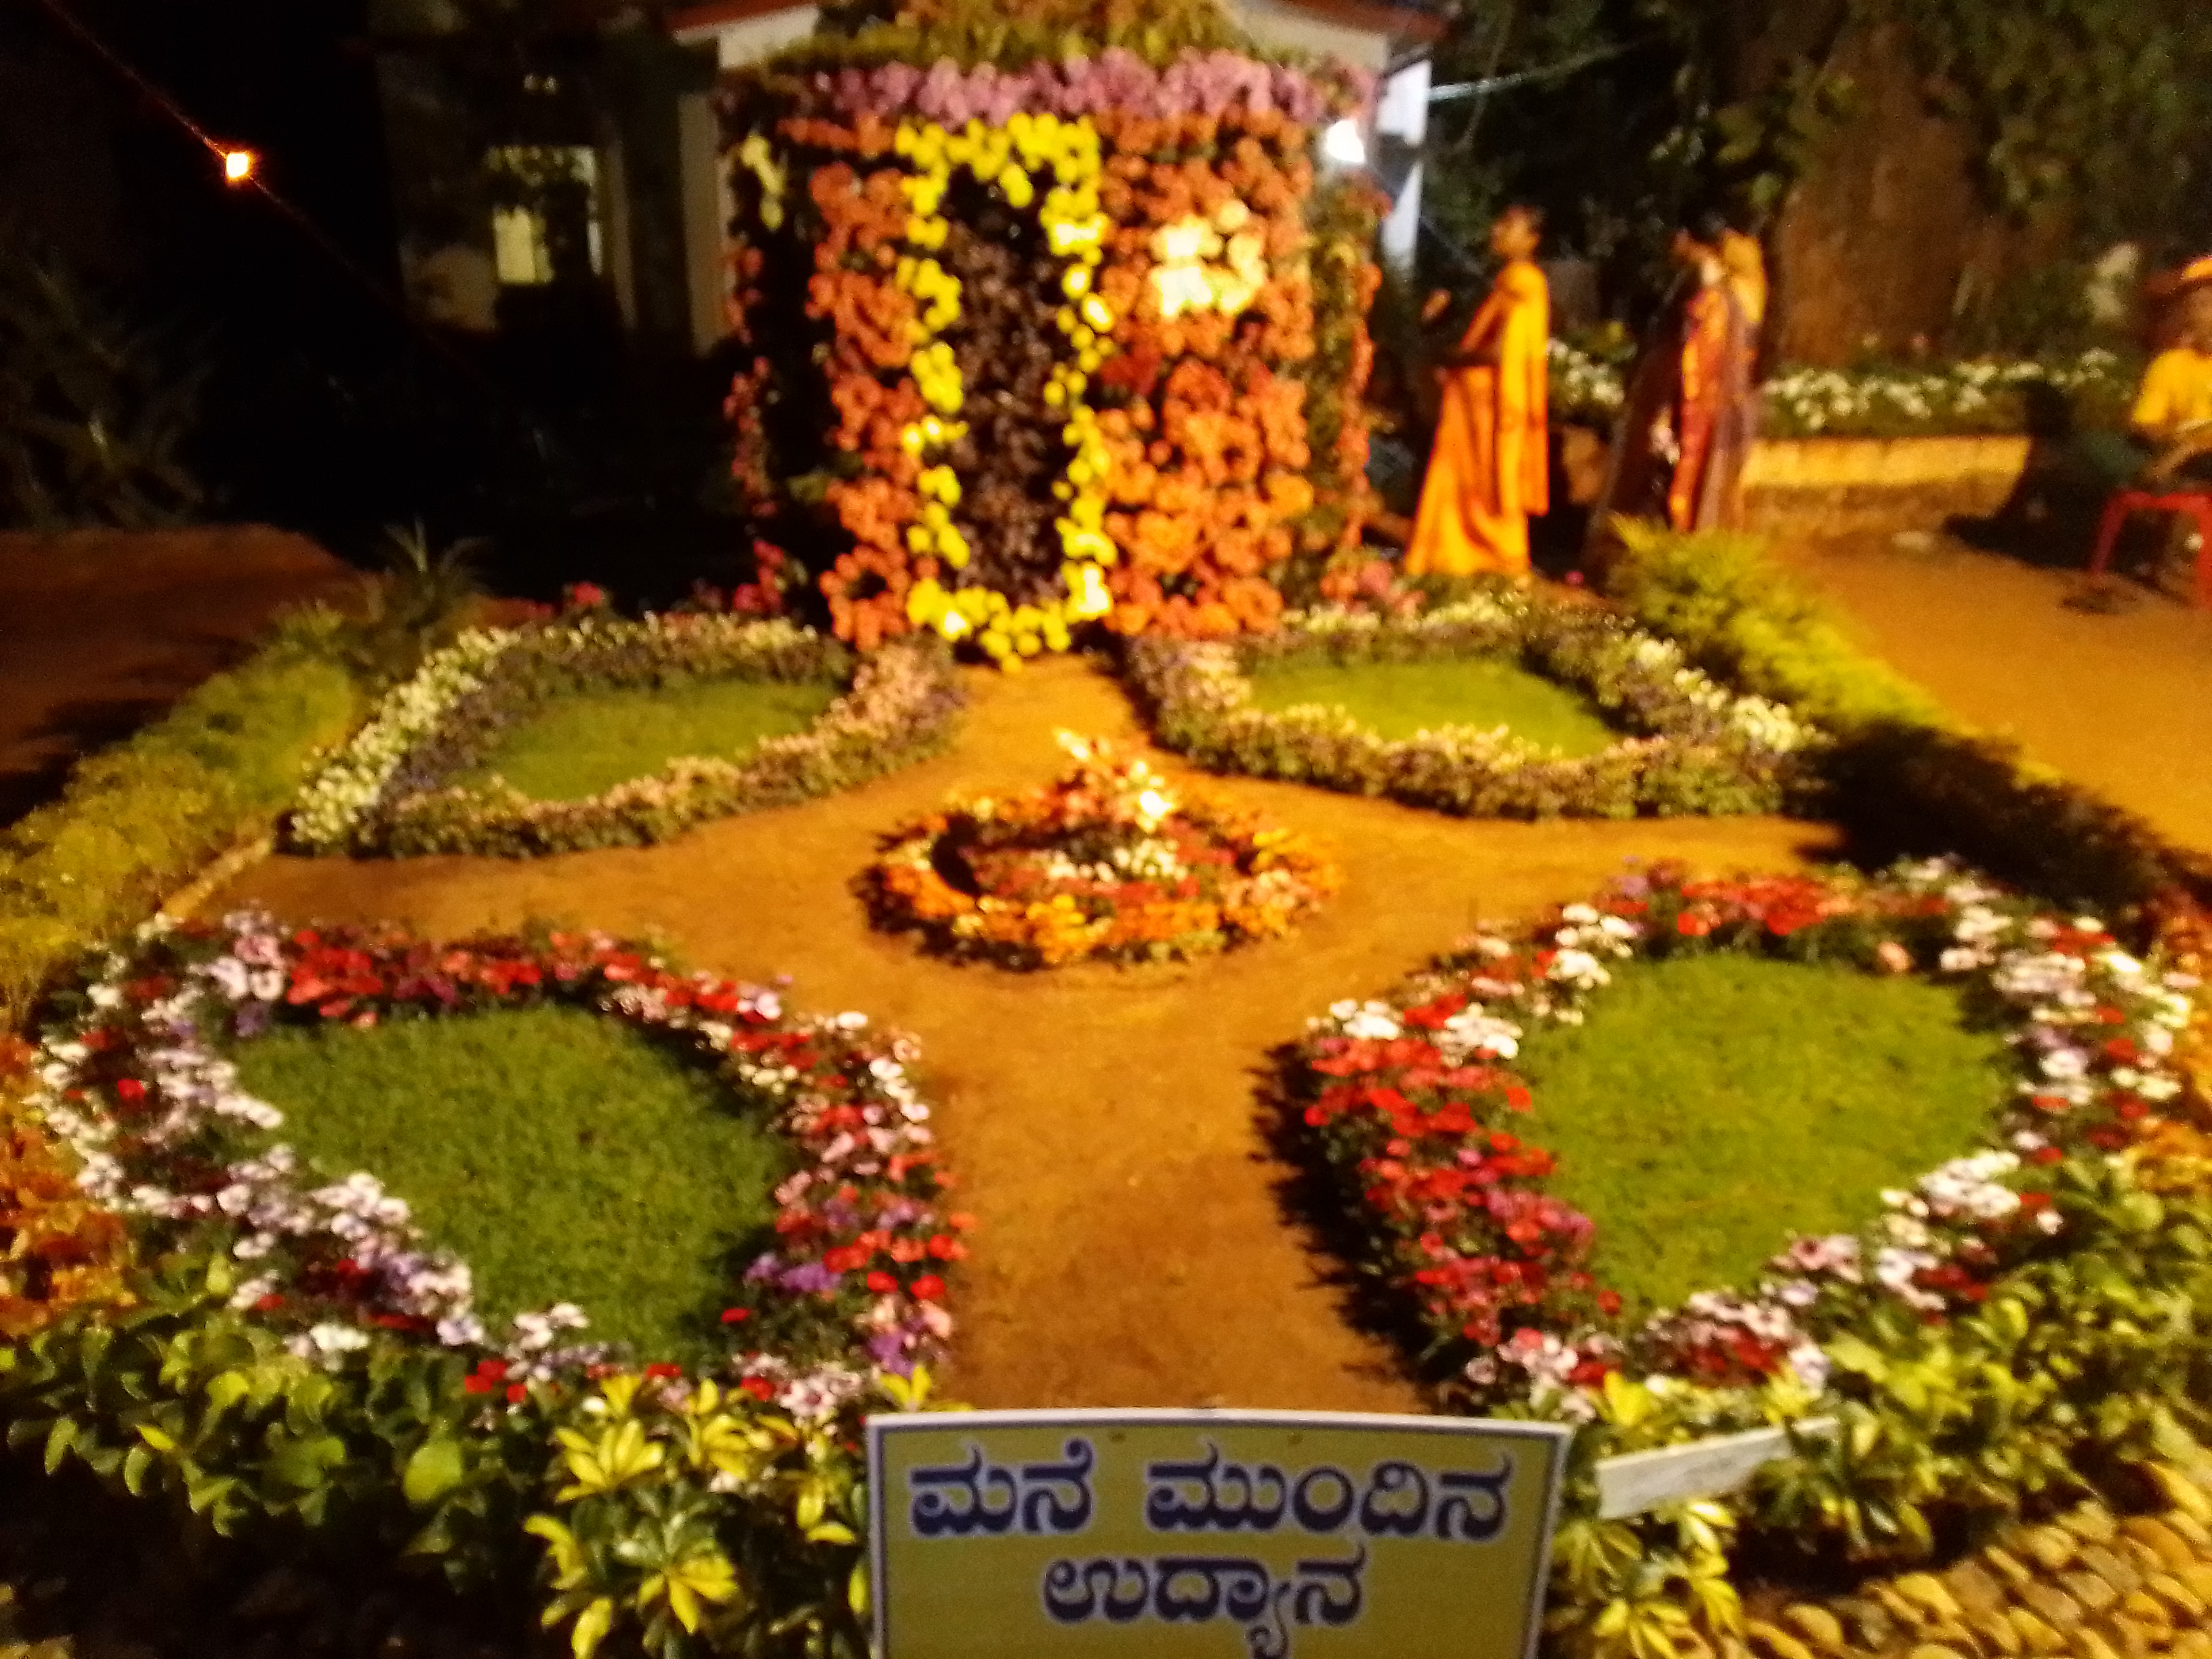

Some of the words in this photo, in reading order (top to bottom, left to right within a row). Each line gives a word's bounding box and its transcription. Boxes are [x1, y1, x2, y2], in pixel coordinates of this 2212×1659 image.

[911, 1438, 1092, 1534] ಮನೆ
[1147, 1441, 1511, 1540] ಮುಂದಿನ
[1044, 1544, 1366, 1659] ಉದ್ಯಾನ
